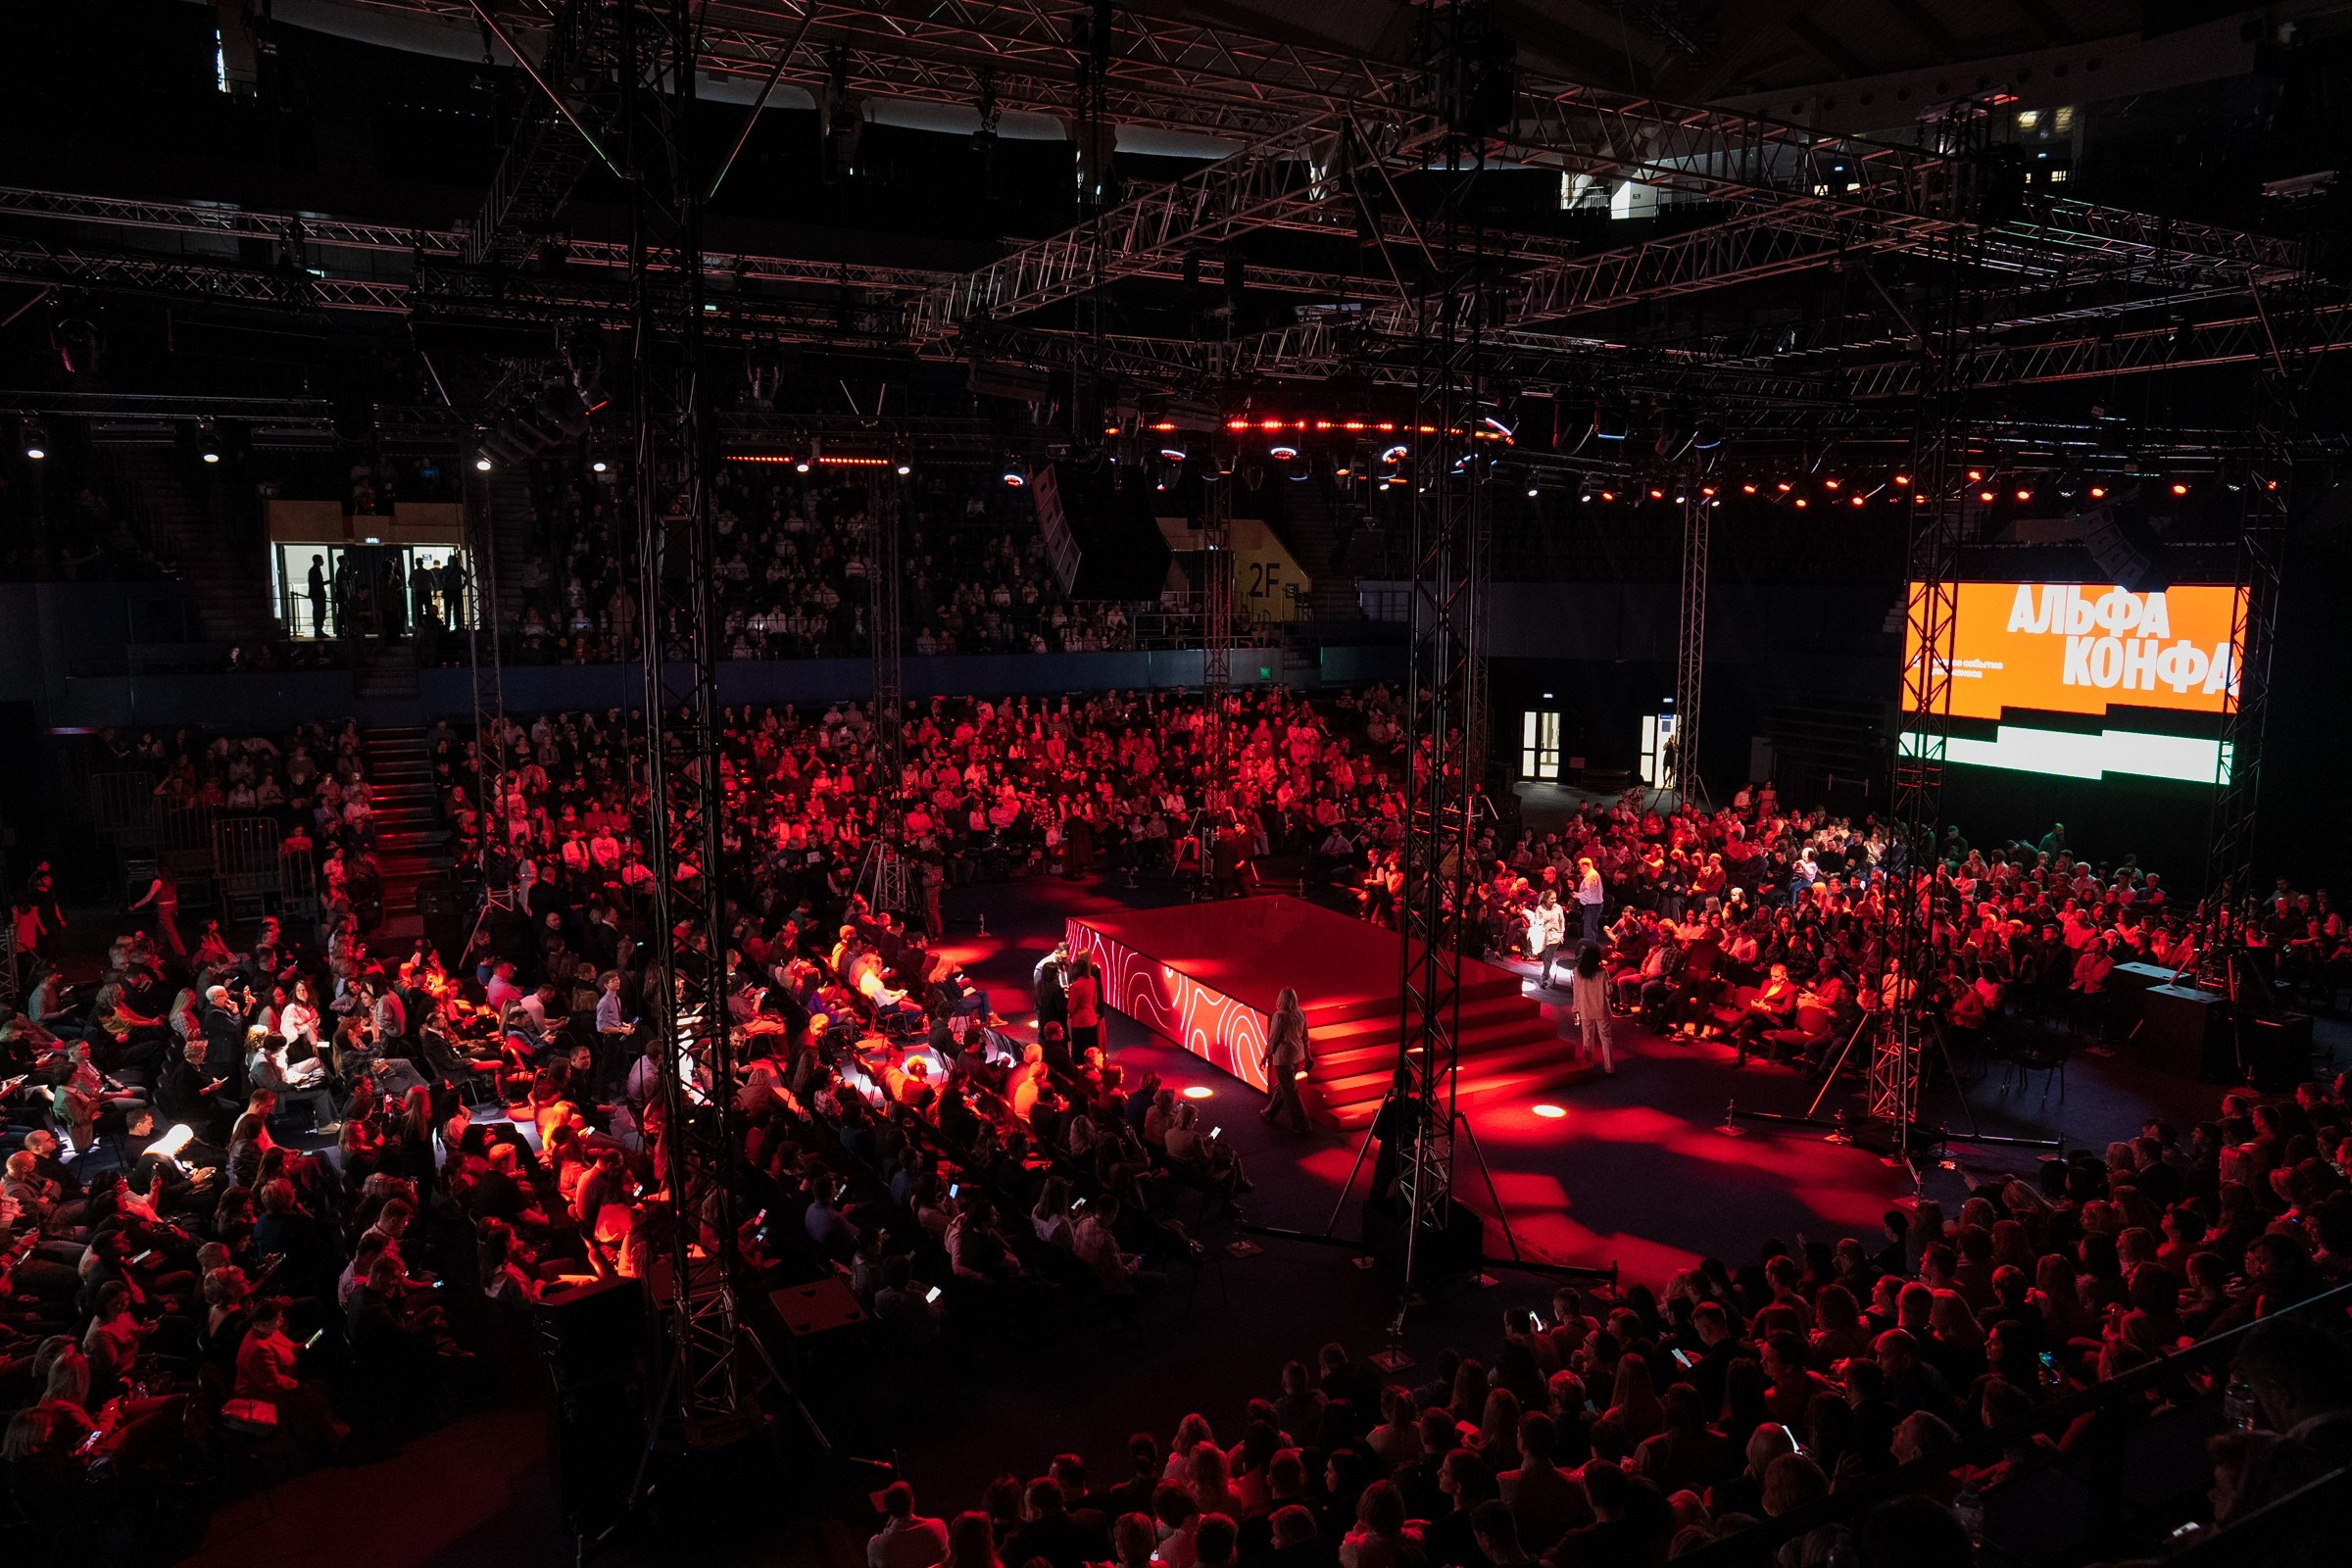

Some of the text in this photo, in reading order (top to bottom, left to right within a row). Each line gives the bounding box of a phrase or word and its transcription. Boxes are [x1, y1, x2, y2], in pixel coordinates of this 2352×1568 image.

[1250, 563, 1280, 597] 2F
[2007, 585, 2171, 638] АЛЬФА
[2063, 636, 2240, 696] КОНФА
